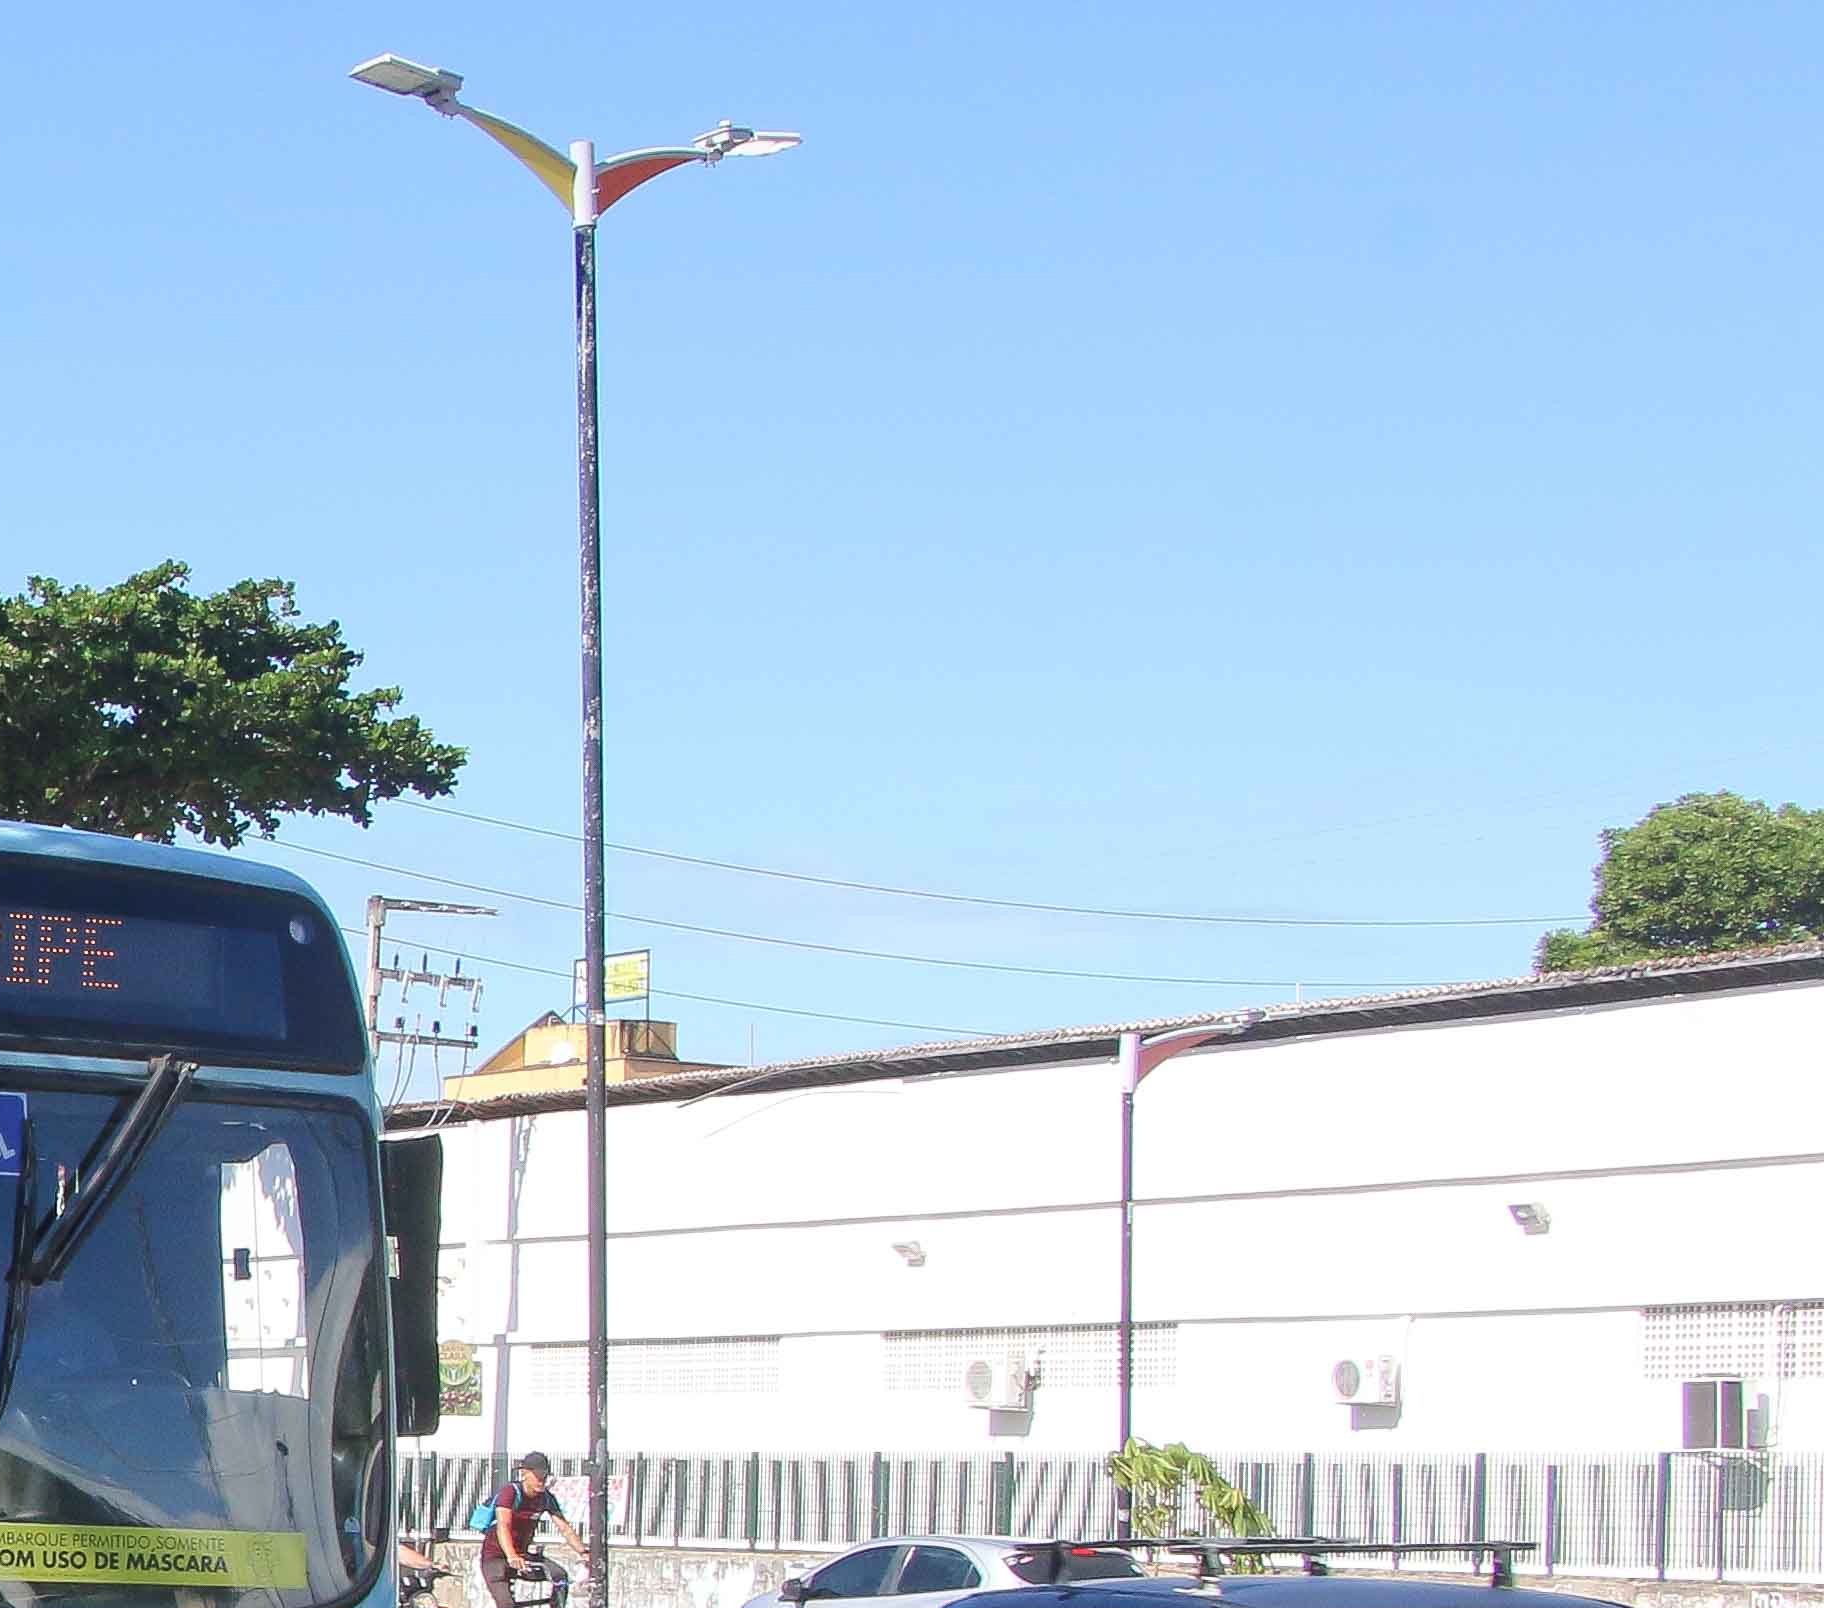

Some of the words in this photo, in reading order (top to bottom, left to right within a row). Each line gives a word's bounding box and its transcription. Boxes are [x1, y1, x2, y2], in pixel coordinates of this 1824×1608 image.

[72, 1534, 150, 1550] PERMITIDO
[156, 1536, 225, 1551] SOMENTE
[42, 1551, 87, 1570] USO
[95, 1552, 119, 1571] DE
[126, 1549, 228, 1574] MÁSCARA
